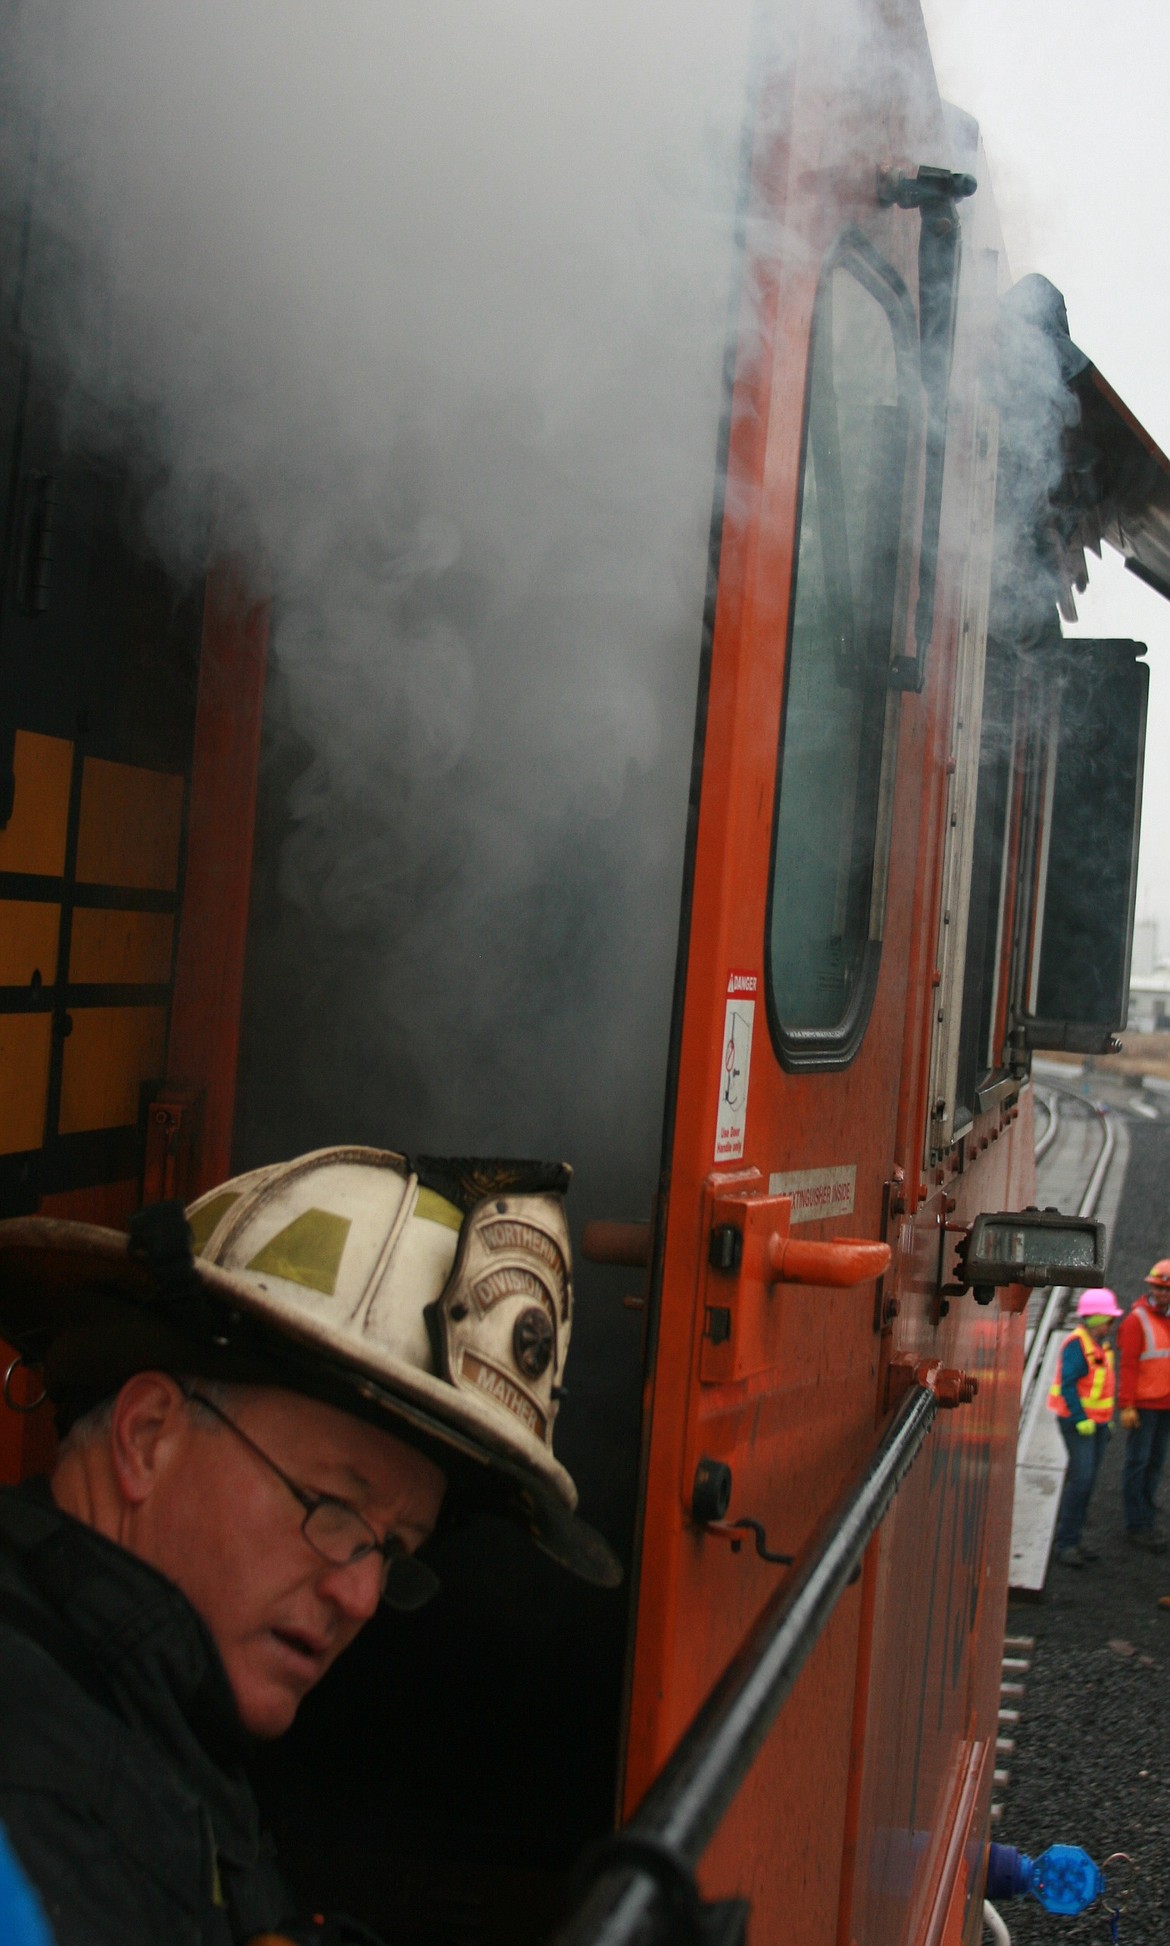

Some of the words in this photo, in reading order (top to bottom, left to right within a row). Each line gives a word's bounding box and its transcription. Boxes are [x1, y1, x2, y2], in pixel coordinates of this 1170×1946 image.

[734, 975, 757, 991] DANGER
[721, 1128, 729, 1138] Use
[717, 1142, 731, 1154] Handle
[833, 1183, 850, 1202] INSIDE
[482, 1222, 557, 1265] NORTHERN
[477, 1269, 544, 1304] DIVISION
[477, 1364, 538, 1431] MATHER
